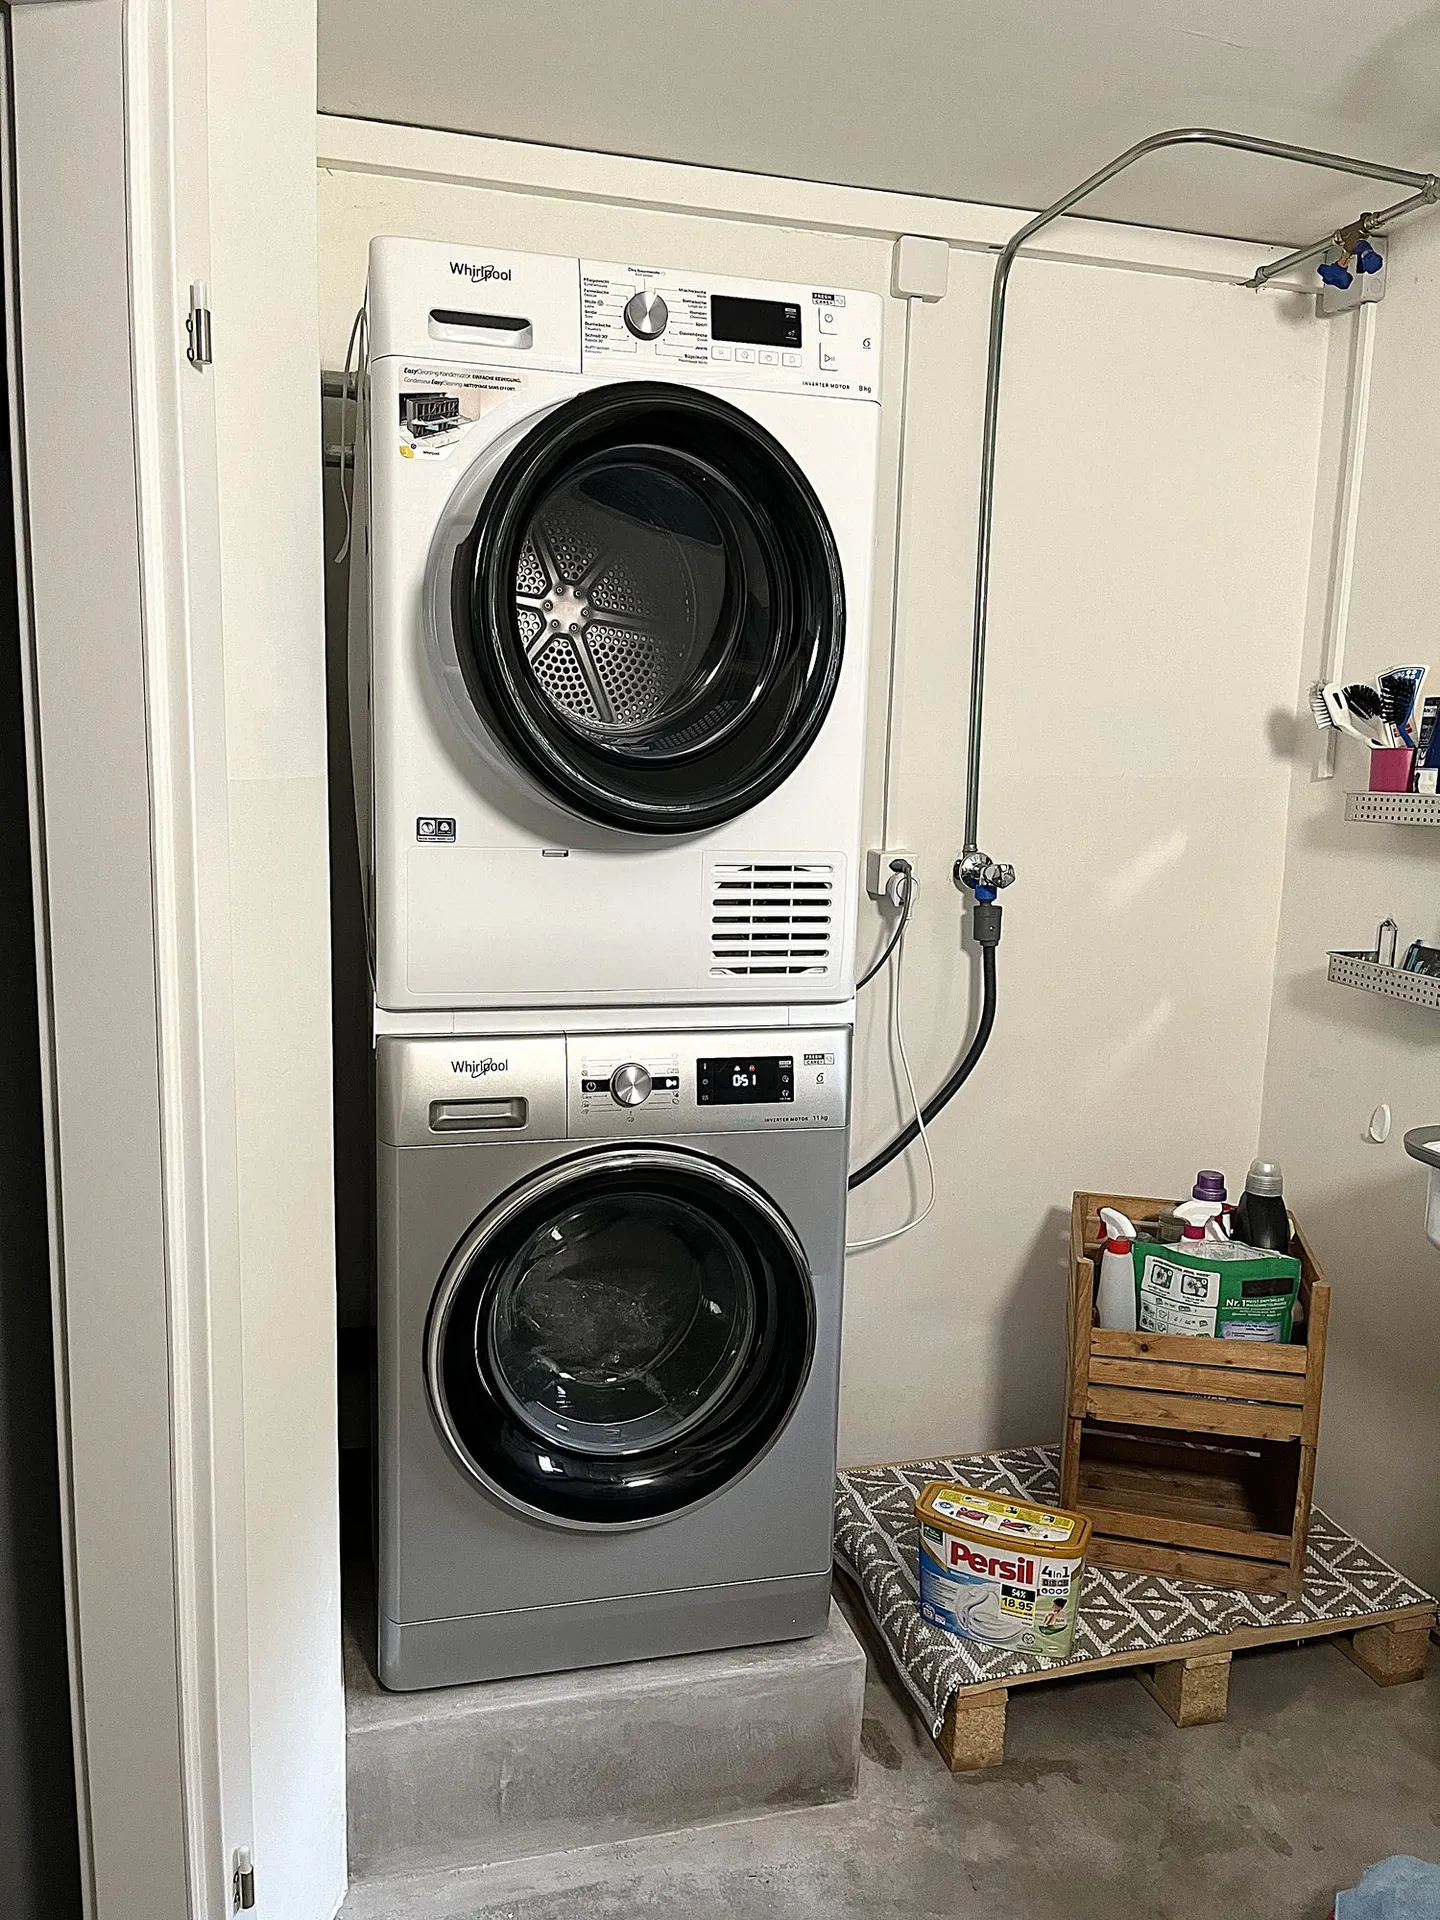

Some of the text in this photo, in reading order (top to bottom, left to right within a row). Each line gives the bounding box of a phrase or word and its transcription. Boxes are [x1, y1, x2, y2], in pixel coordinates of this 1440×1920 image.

[449, 261, 512, 283] Whirlpool
[450, 1058, 508, 1078] Whirlpool
[950, 1540, 1034, 1585] Persil
[1011, 1588, 1026, 1599] 54%
[1001, 1597, 1034, 1611] 18.95
